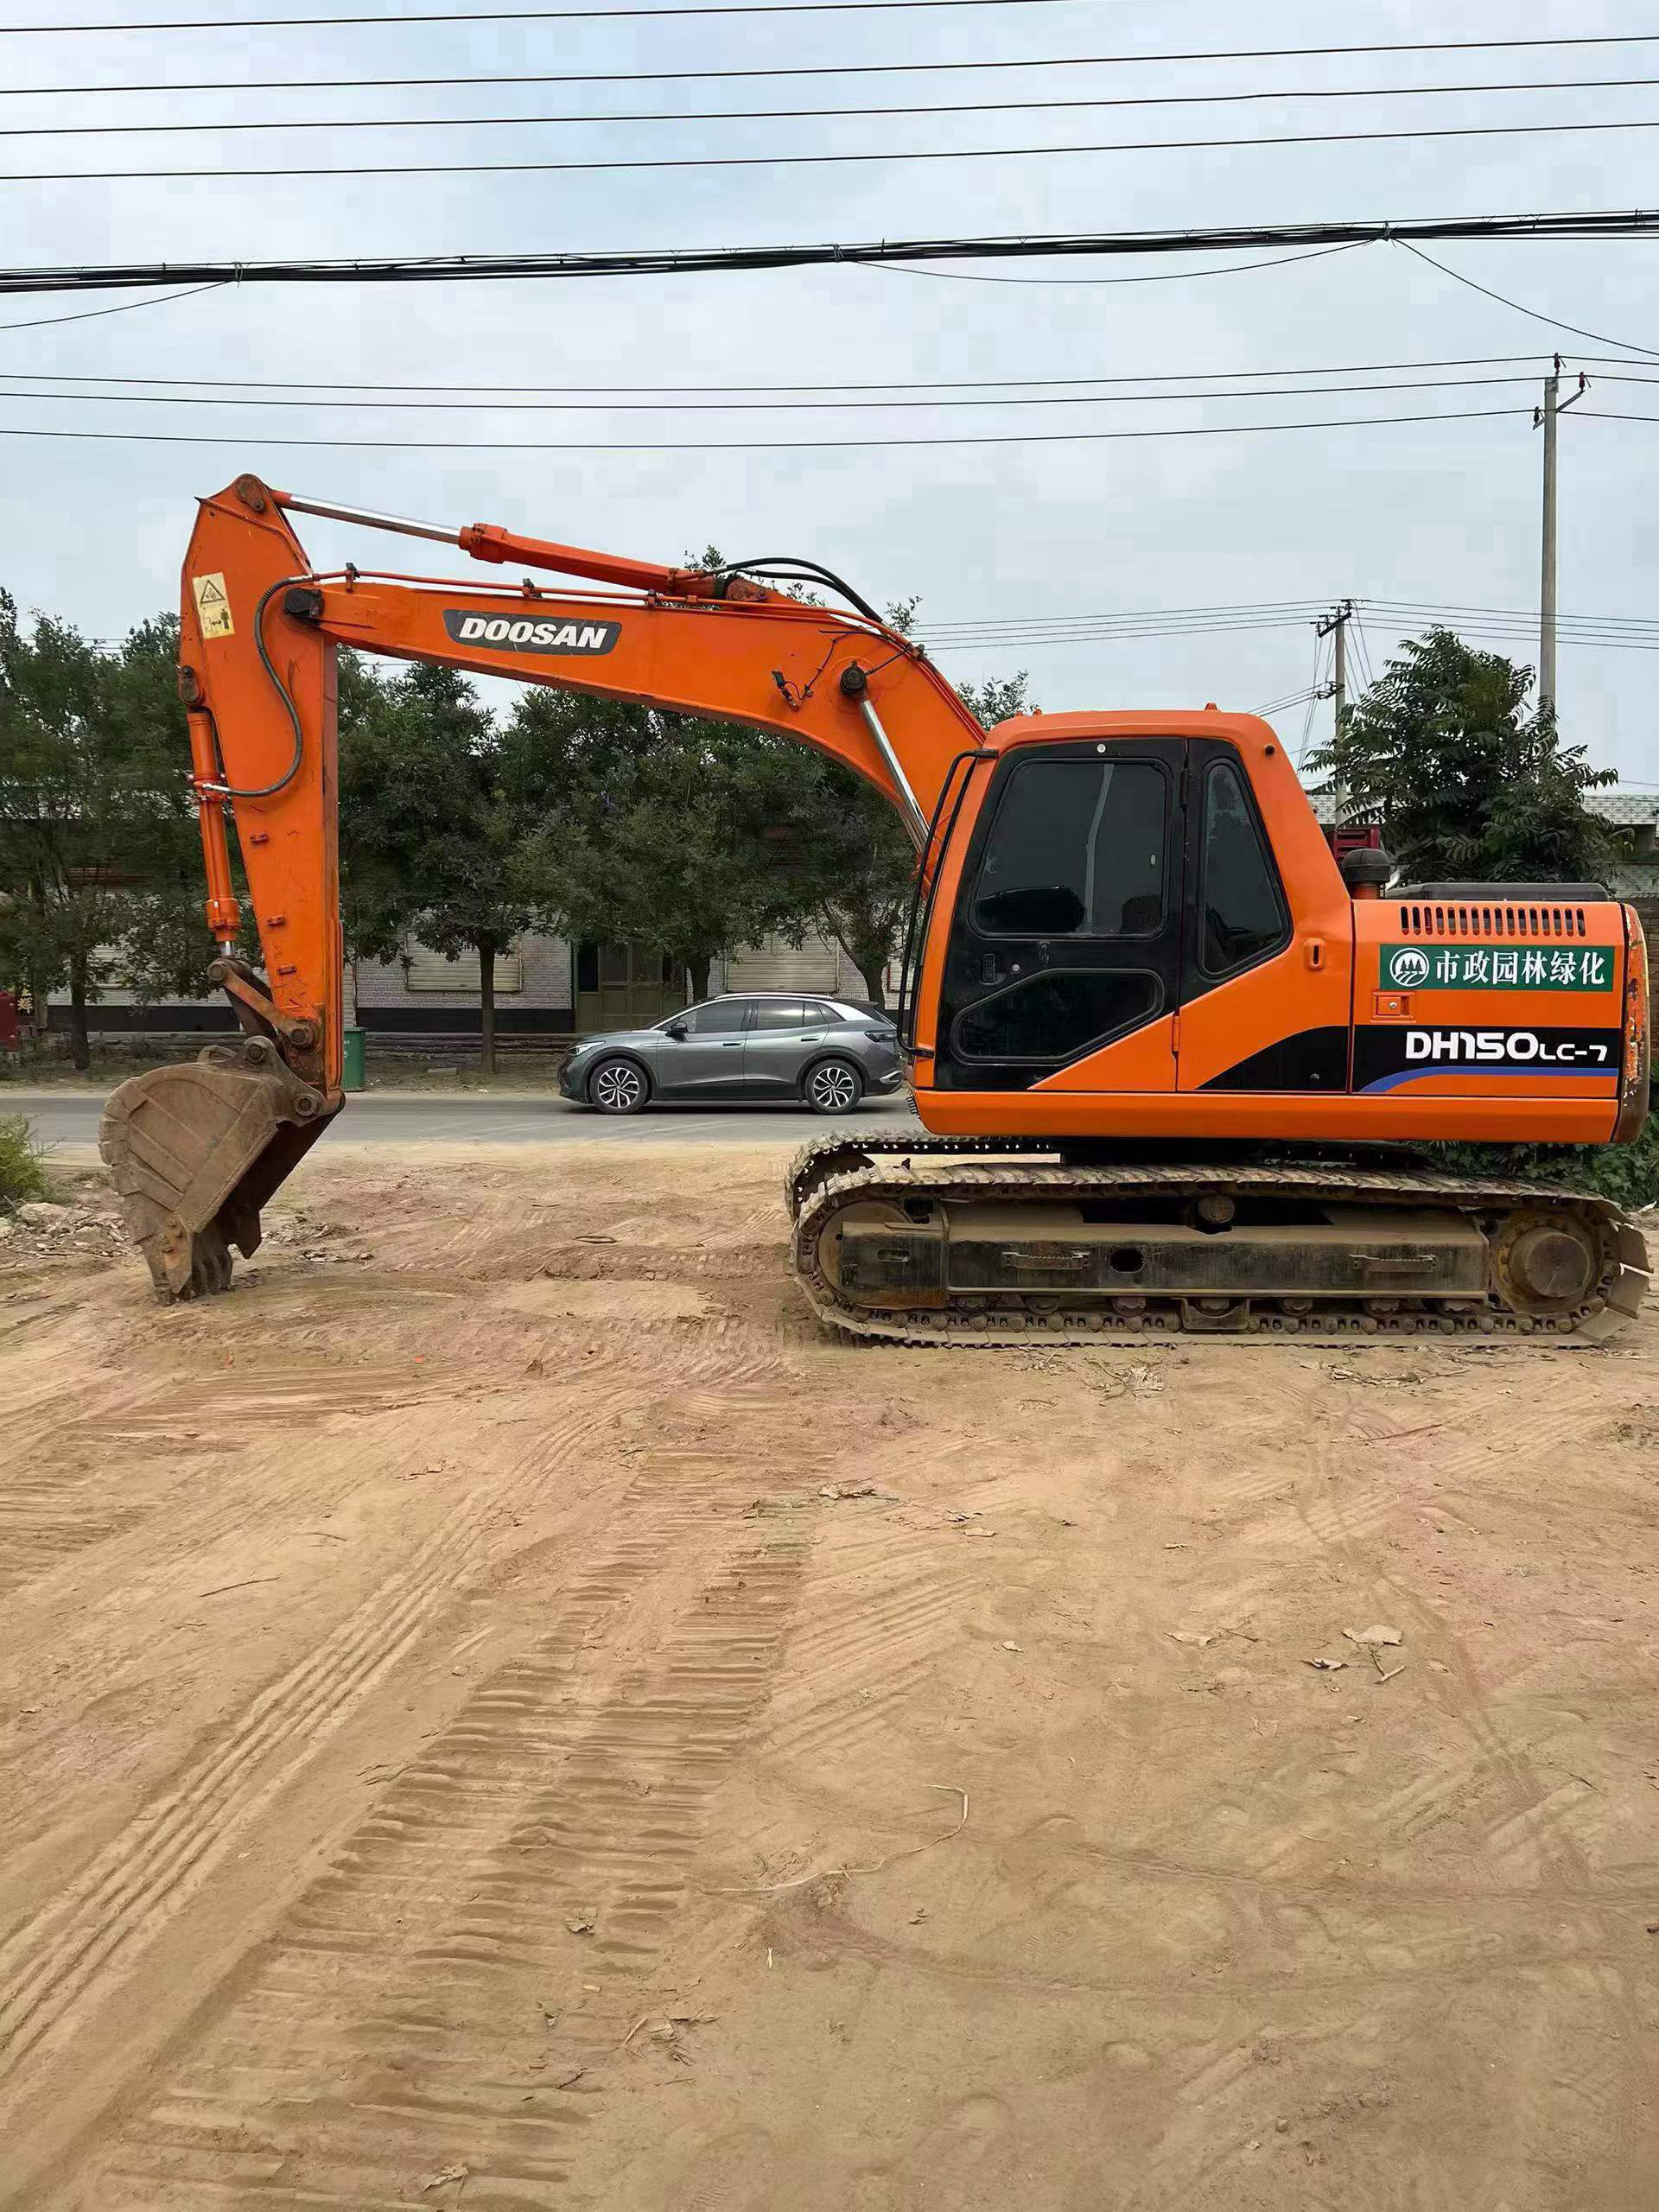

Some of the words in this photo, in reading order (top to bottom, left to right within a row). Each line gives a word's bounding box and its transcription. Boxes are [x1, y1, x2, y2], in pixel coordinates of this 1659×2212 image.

[459, 617, 607, 649] DOOSAN
[1434, 950, 1605, 985] 市政园林绿化
